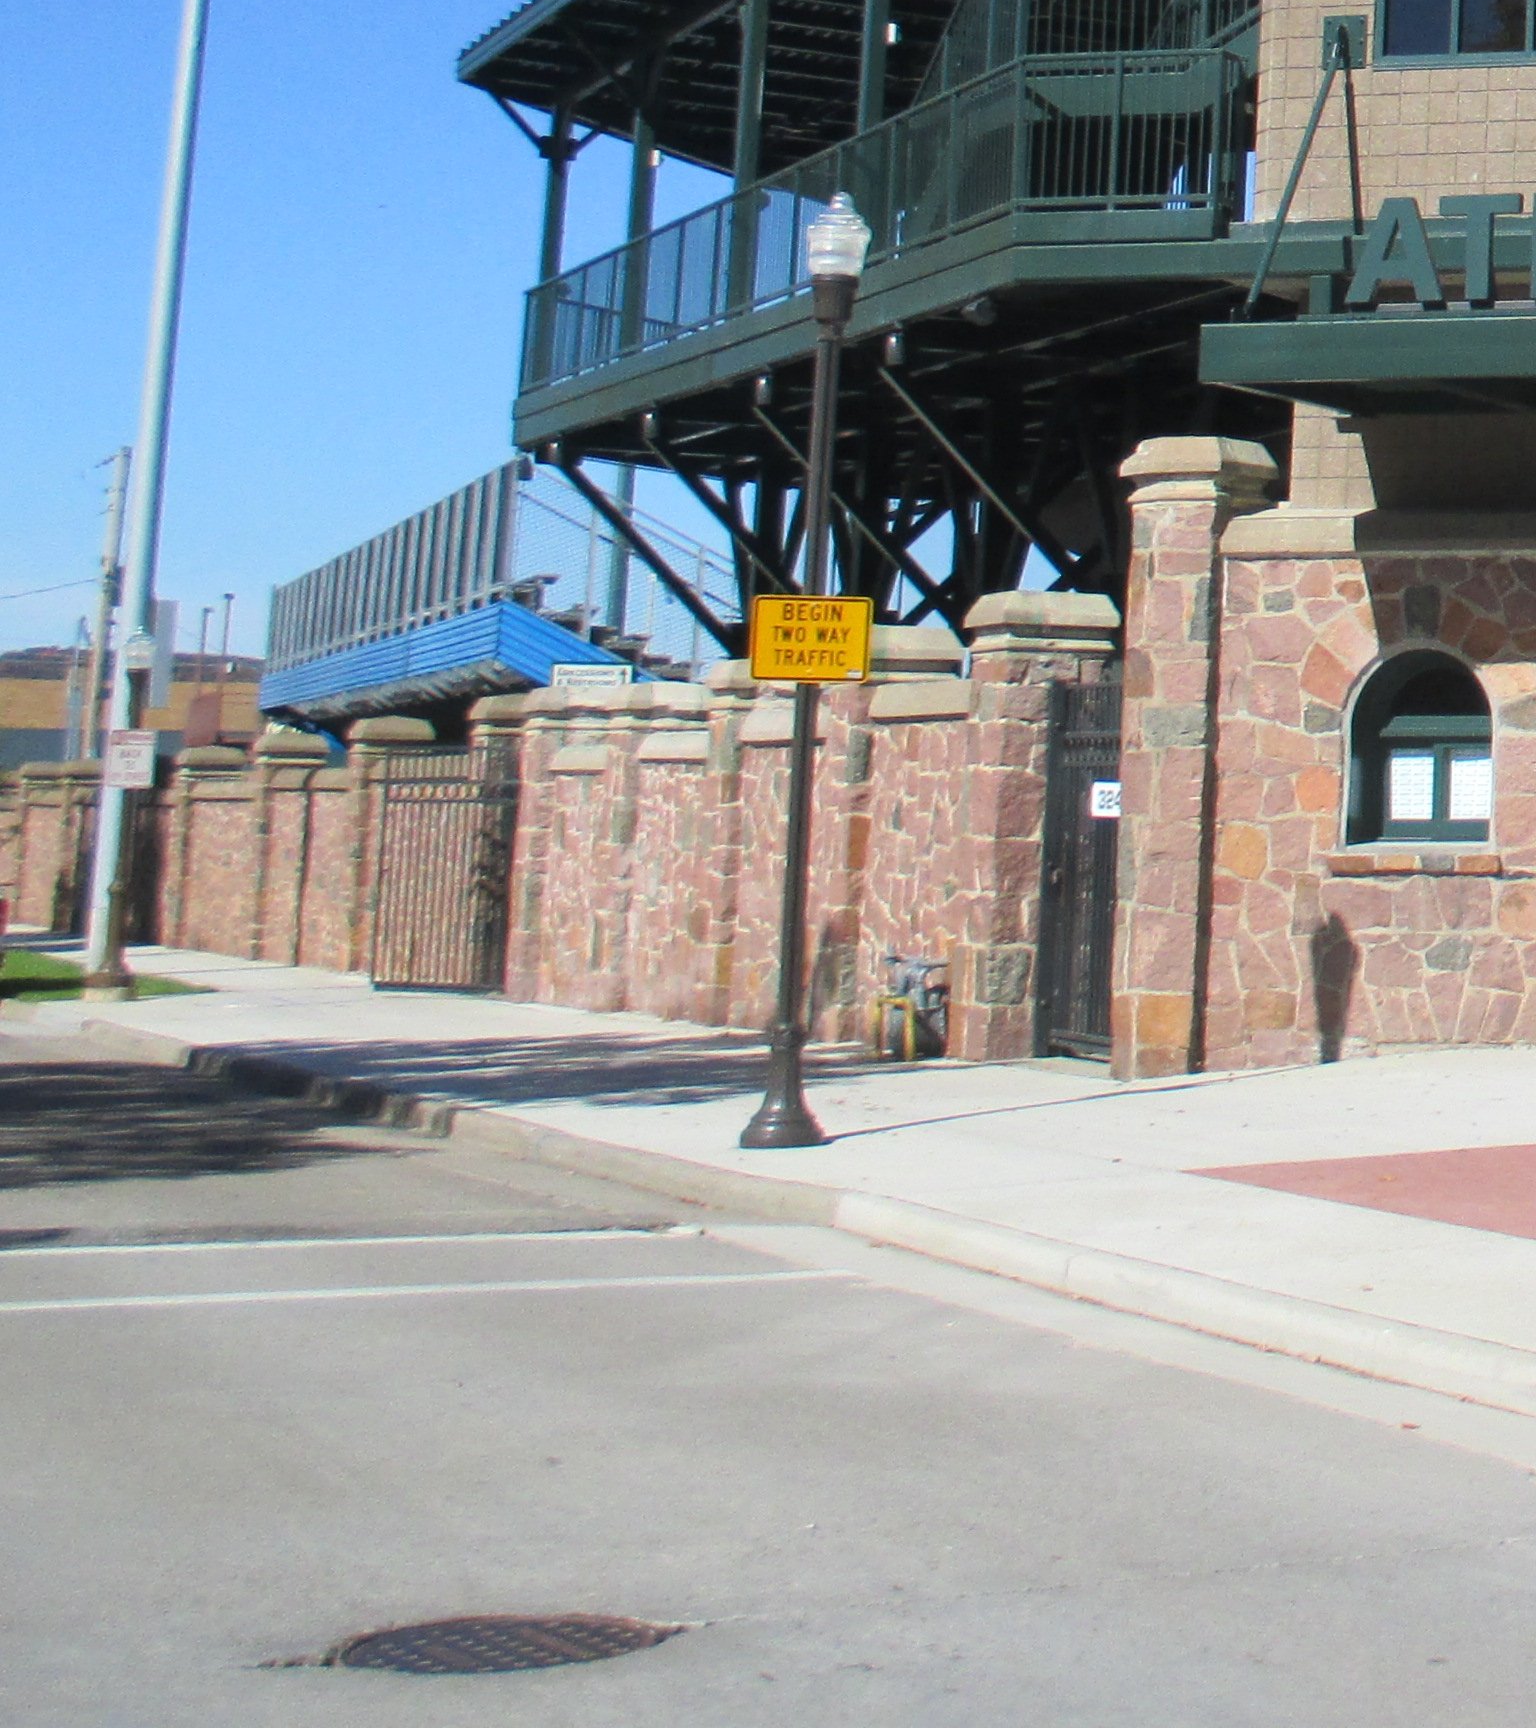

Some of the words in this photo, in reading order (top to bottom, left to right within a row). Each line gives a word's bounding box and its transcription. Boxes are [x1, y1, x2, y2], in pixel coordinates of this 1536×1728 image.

[782, 603, 843, 622] BEGIN
[772, 625, 806, 643] TWO
[816, 626, 851, 643] WAY
[774, 648, 847, 666] TRAFFIC
